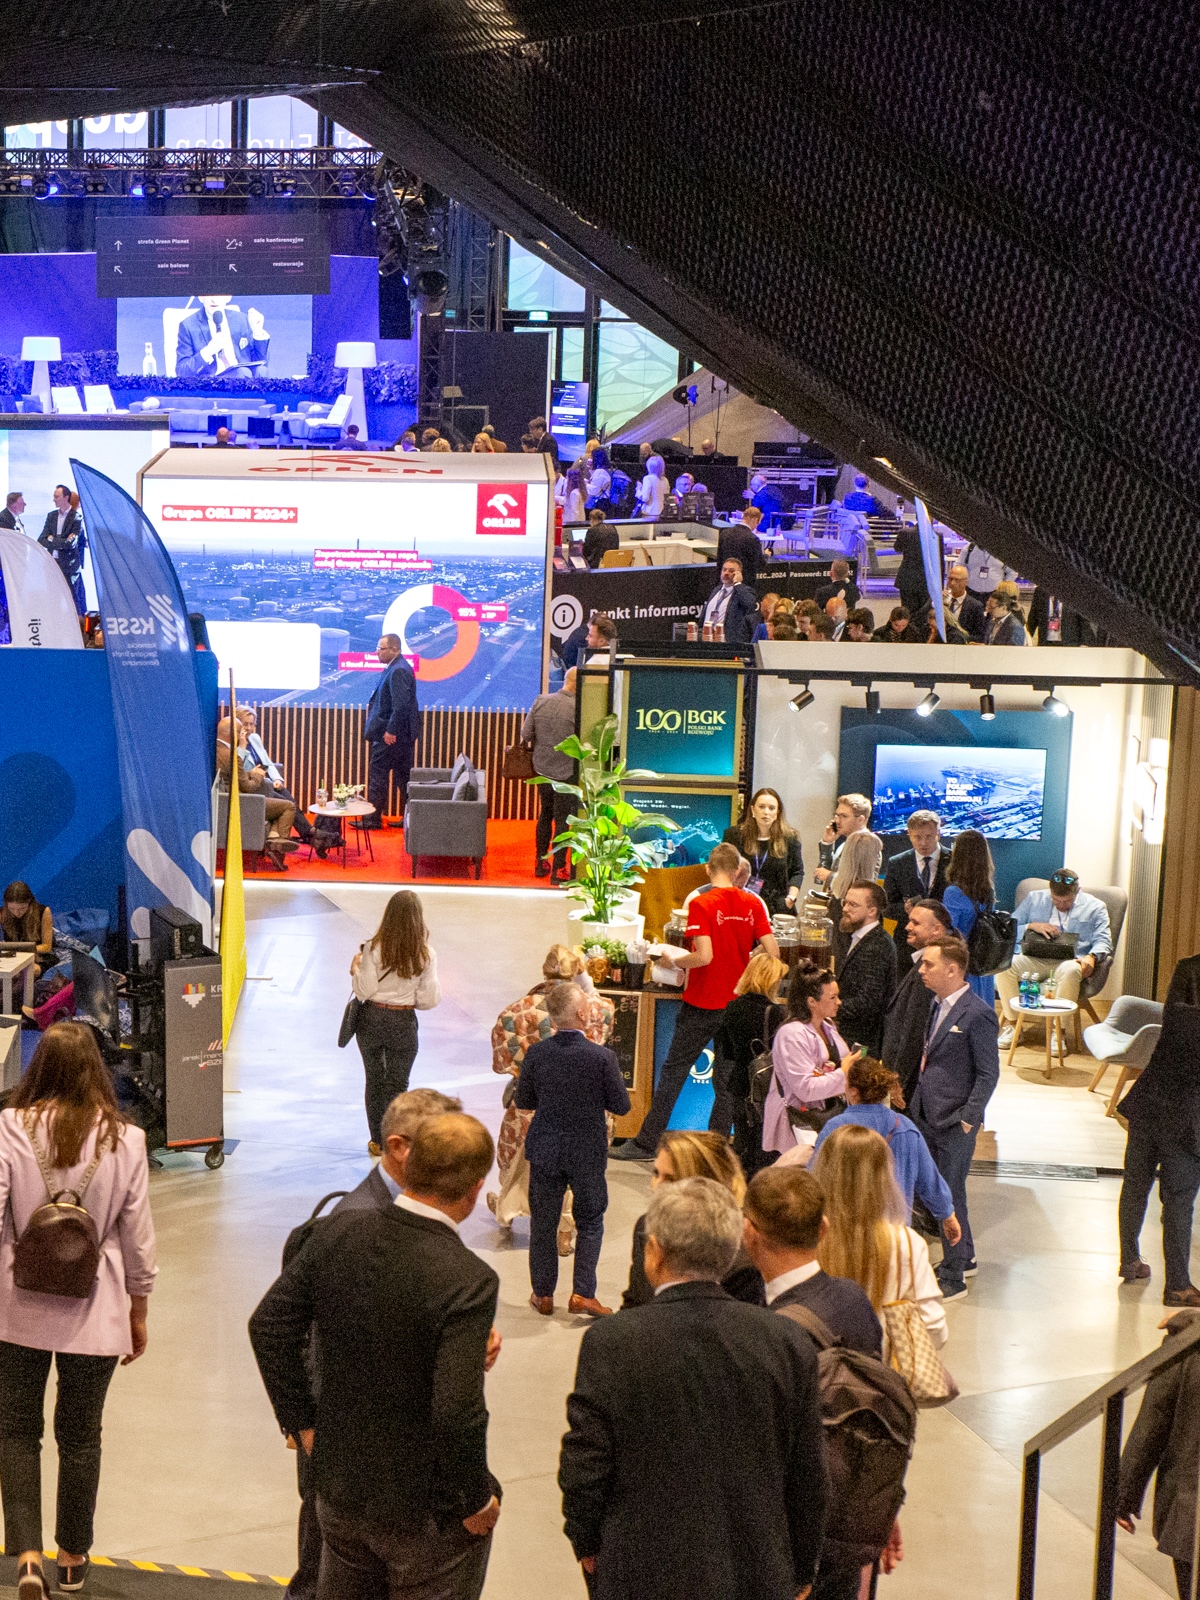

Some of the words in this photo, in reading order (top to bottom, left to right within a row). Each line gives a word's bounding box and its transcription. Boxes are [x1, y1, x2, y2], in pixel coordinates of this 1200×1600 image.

[247, 466, 444, 475] ORLEN
[162, 506, 203, 521] Grupa
[204, 507, 251, 520] ORLEN
[253, 508, 296, 521] 2024+
[482, 517, 521, 528] ORLEN
[457, 607, 477, 617] 15%
[589, 606, 631, 620] Pnkt
[635, 708, 682, 731] 100
[687, 709, 727, 725] BGK
